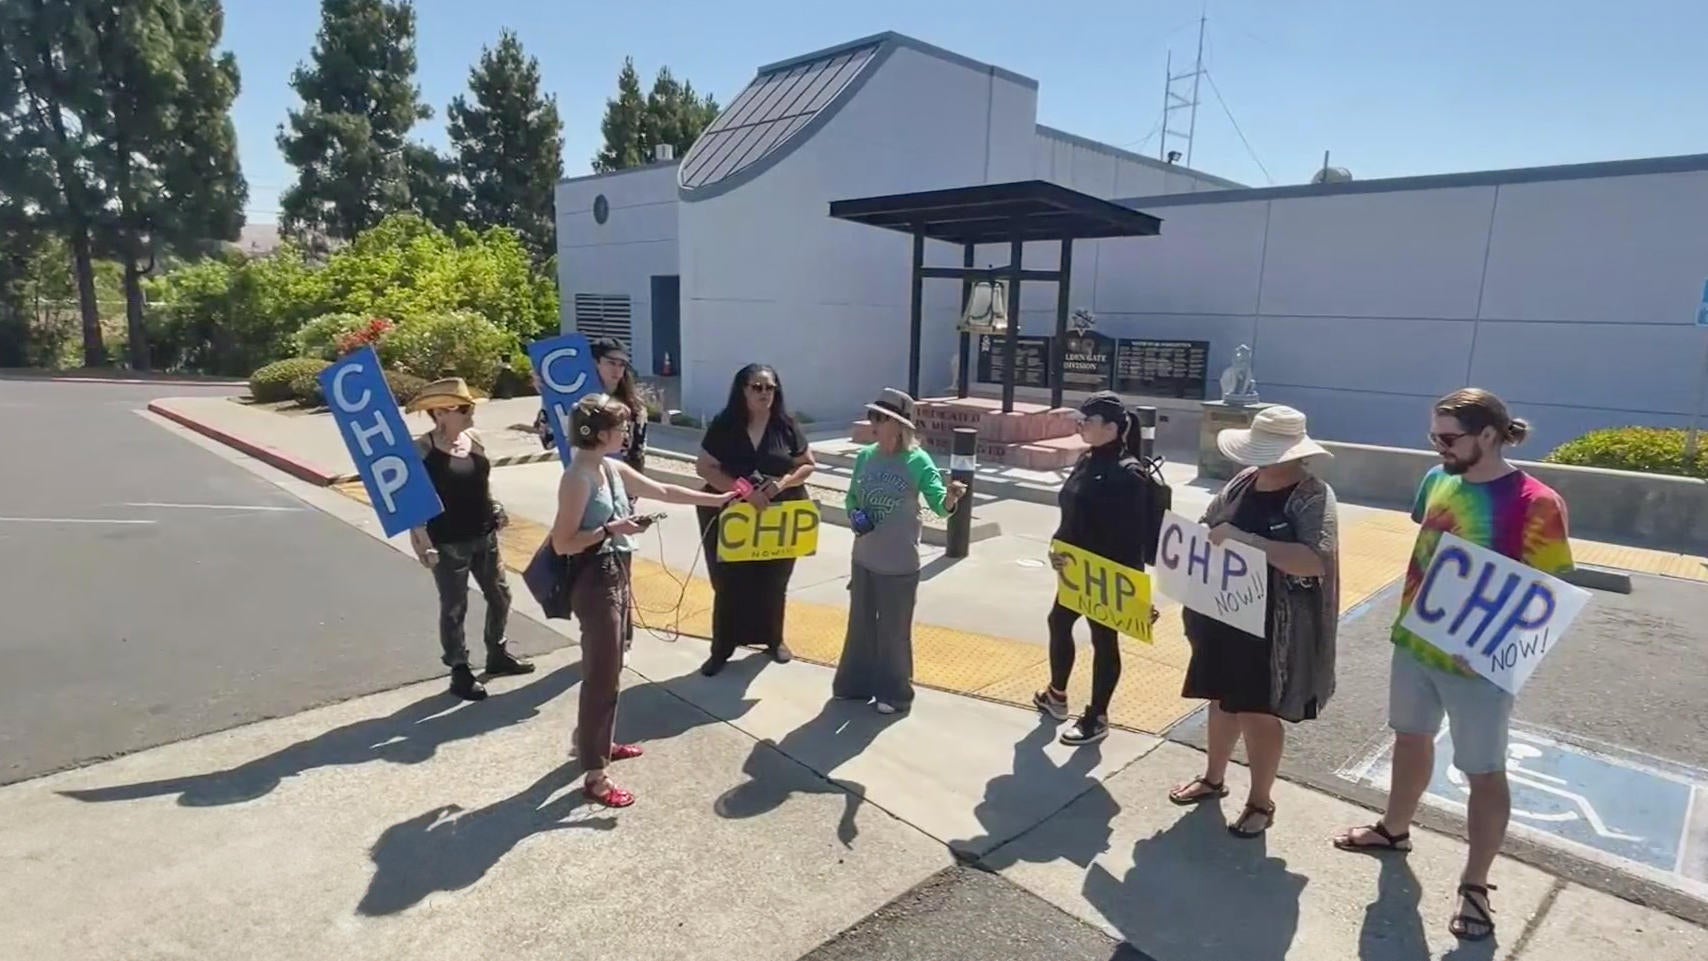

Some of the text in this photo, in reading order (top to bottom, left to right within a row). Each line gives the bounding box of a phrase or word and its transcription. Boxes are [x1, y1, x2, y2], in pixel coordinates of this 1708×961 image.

[333, 363, 409, 513] CHP
[720, 509, 819, 549] CHP
[1162, 523, 1248, 591] CHP
[1057, 551, 1136, 612] CHP
[1214, 571, 1265, 616] NOW!!
[1414, 545, 1556, 657] CHP
[1491, 627, 1549, 673] NOW!
